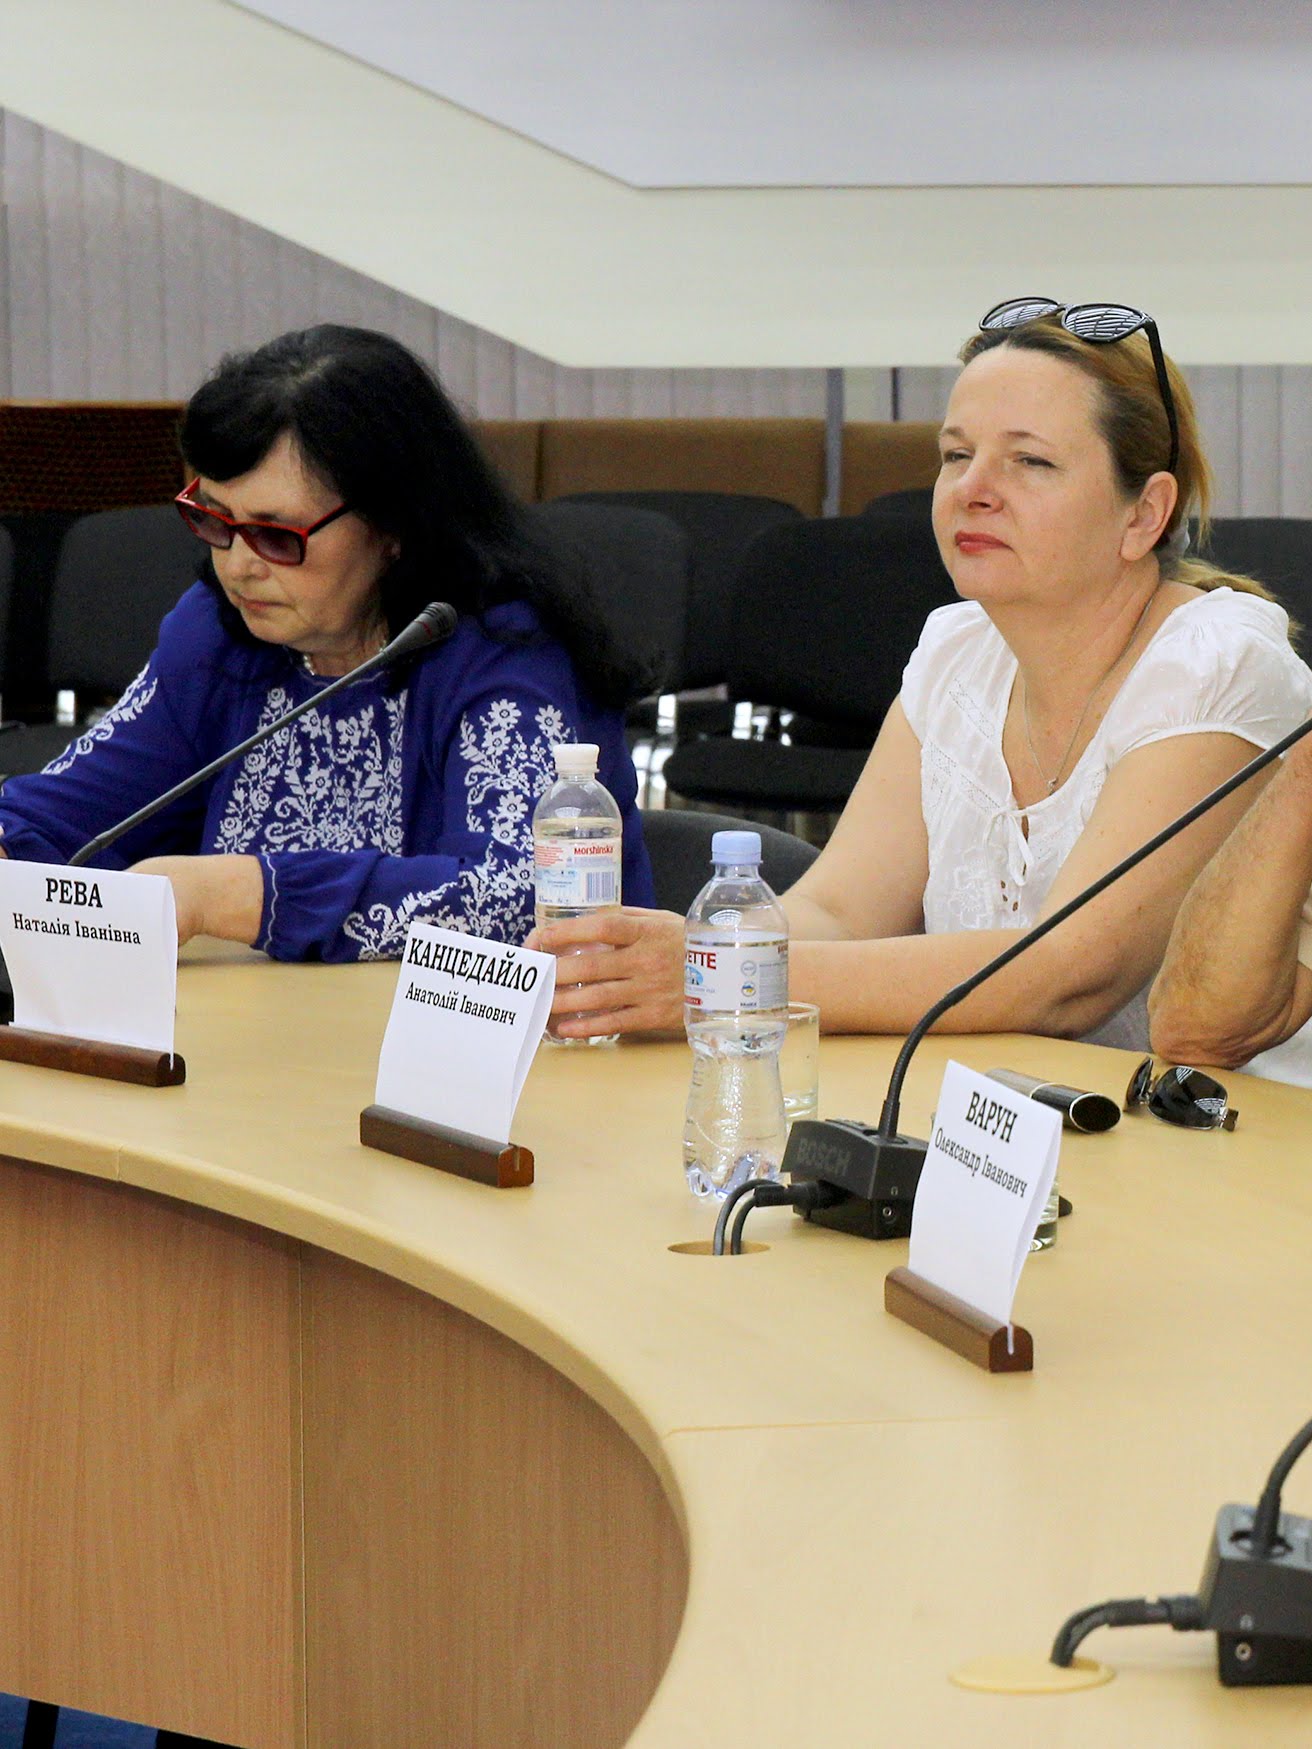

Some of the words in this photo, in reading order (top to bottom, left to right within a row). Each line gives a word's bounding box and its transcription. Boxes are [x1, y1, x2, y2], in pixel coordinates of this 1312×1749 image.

[46, 878, 103, 908] РЕВА
[13, 913, 70, 936] Наталія
[75, 920, 141, 945] Іванівна
[407, 938, 538, 993] КАНЦЕДАЙЛО
[405, 982, 459, 1011] Анатолій
[459, 995, 516, 1025] Іванович
[965, 1091, 1018, 1143] ВАРУН
[935, 1127, 980, 1177] Олександр
[981, 1155, 1027, 1198] Іванович
